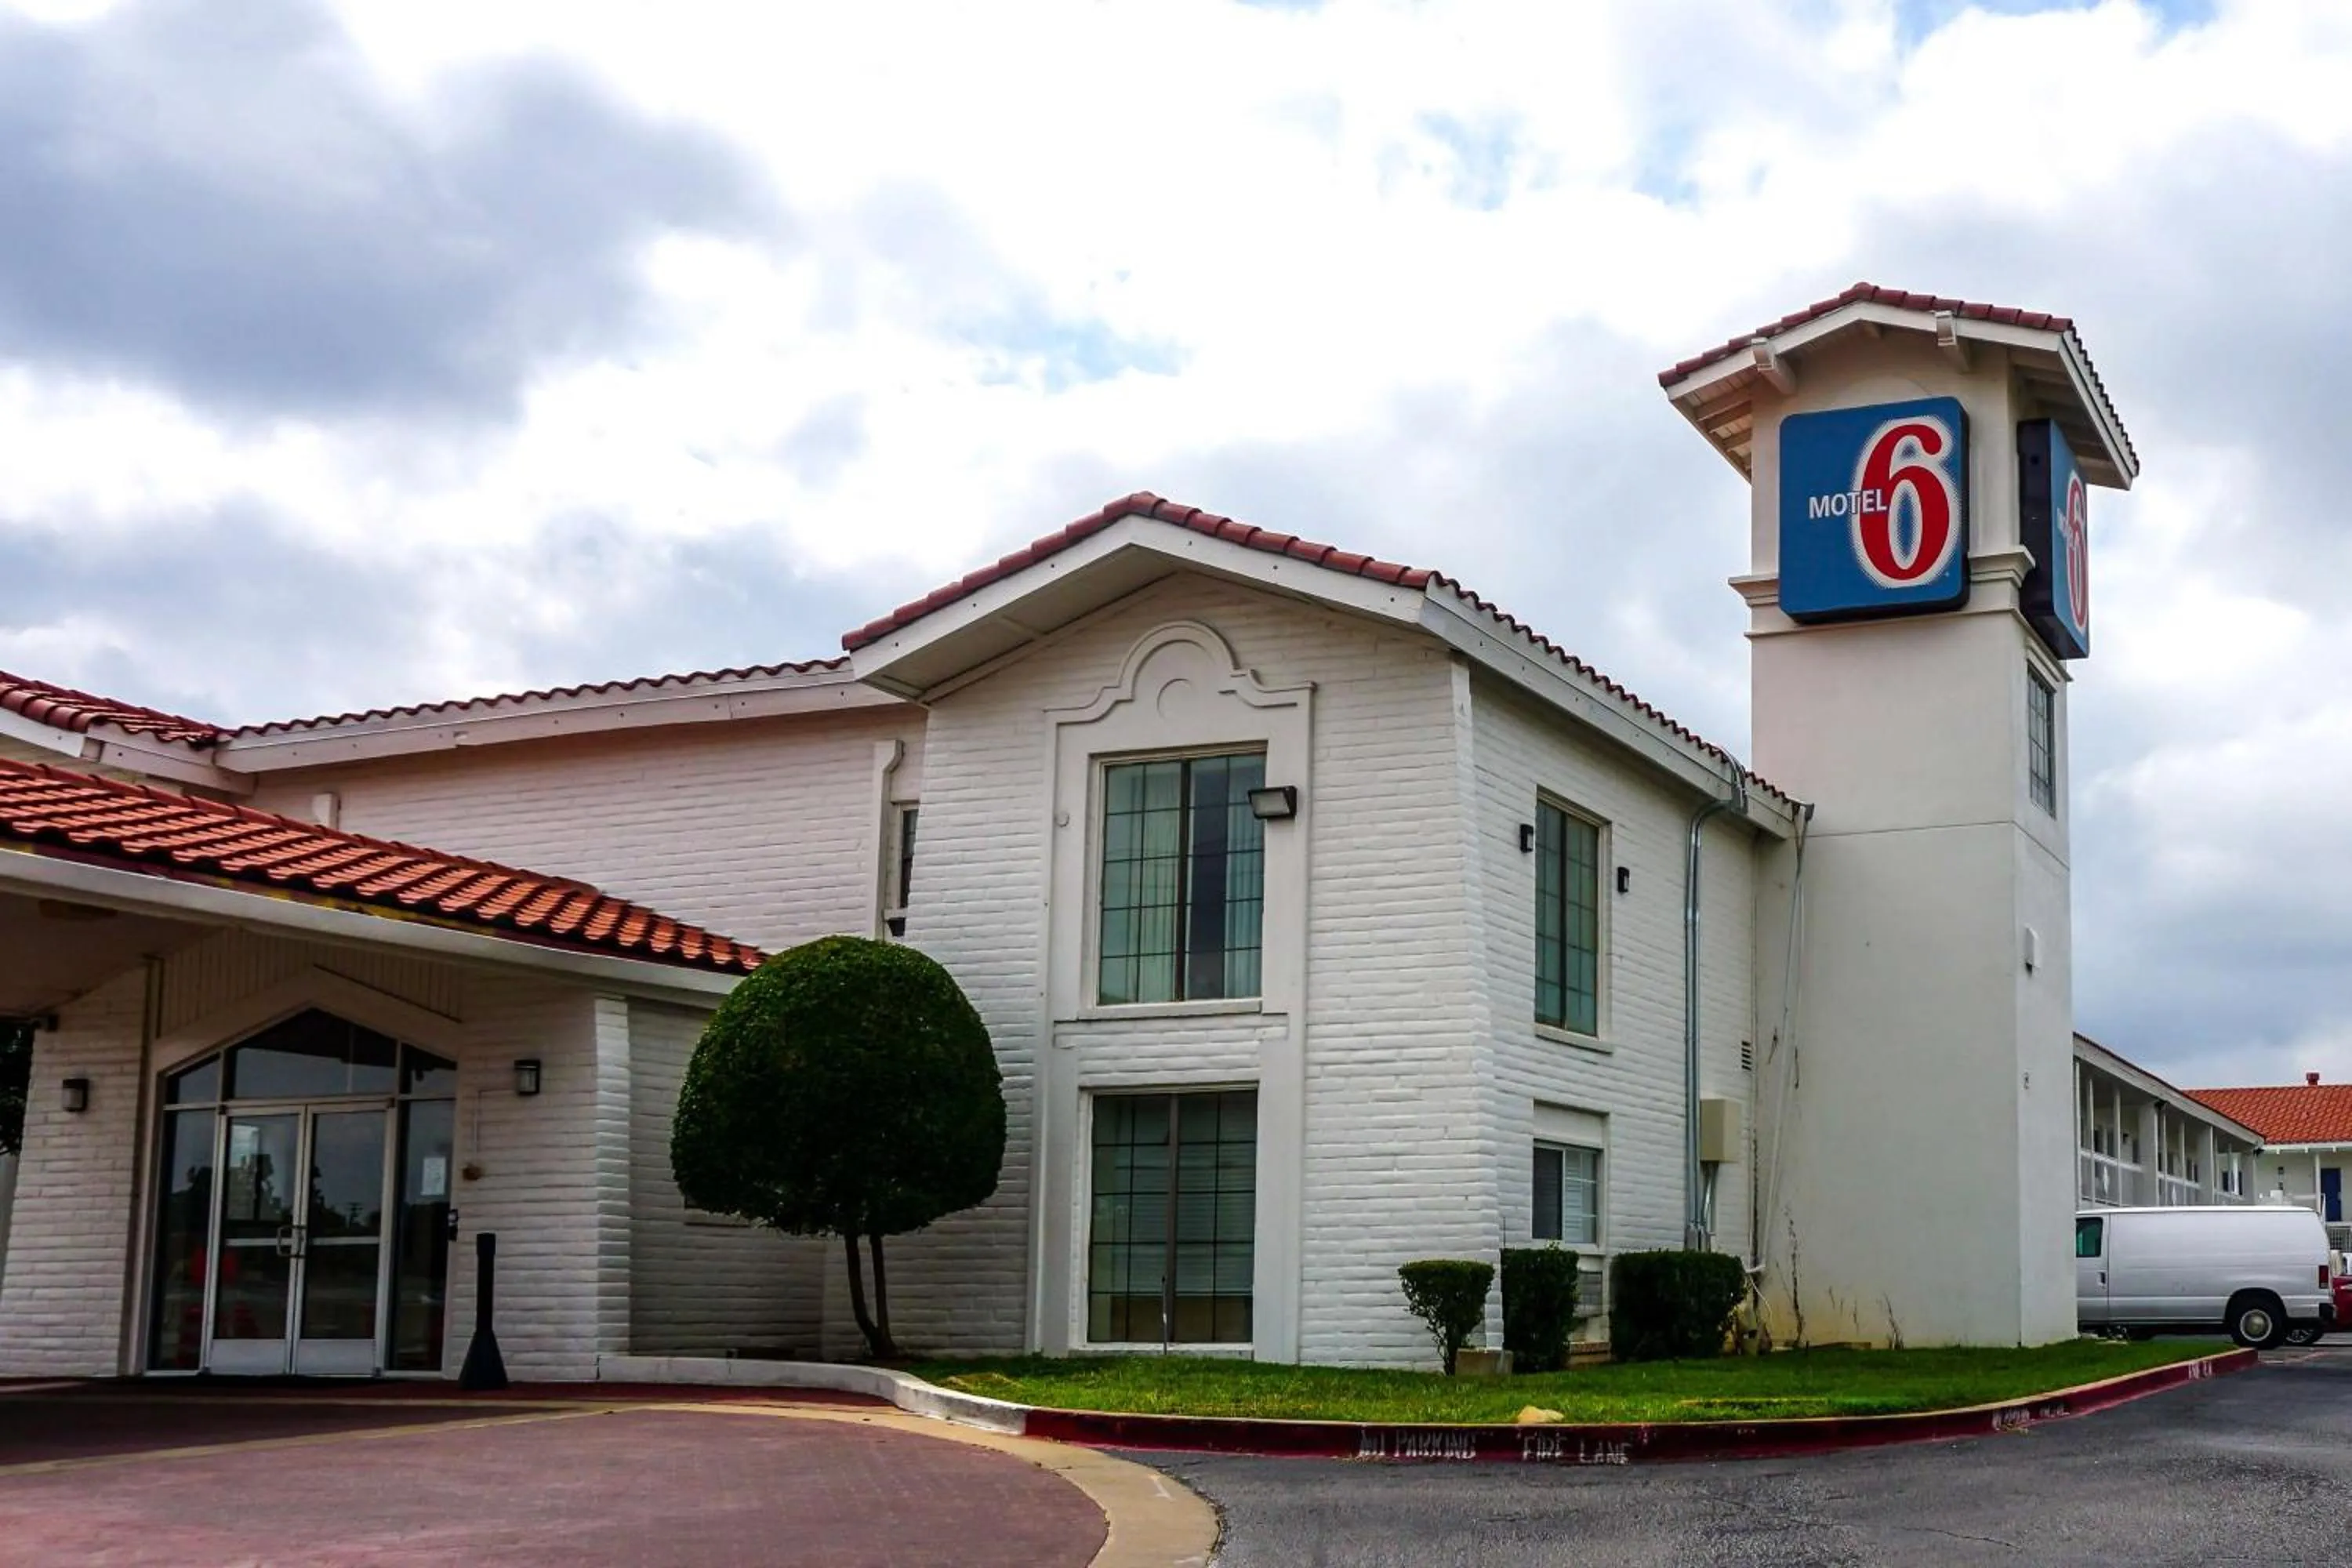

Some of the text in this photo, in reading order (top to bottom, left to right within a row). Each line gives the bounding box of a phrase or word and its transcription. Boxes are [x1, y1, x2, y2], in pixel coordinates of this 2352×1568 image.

[1809, 488, 1888, 520] MOTEL
[1857, 421, 1952, 583] 6
[1394, 1429, 1476, 1459] PARKING
[1580, 1440, 1632, 1465] LANE
